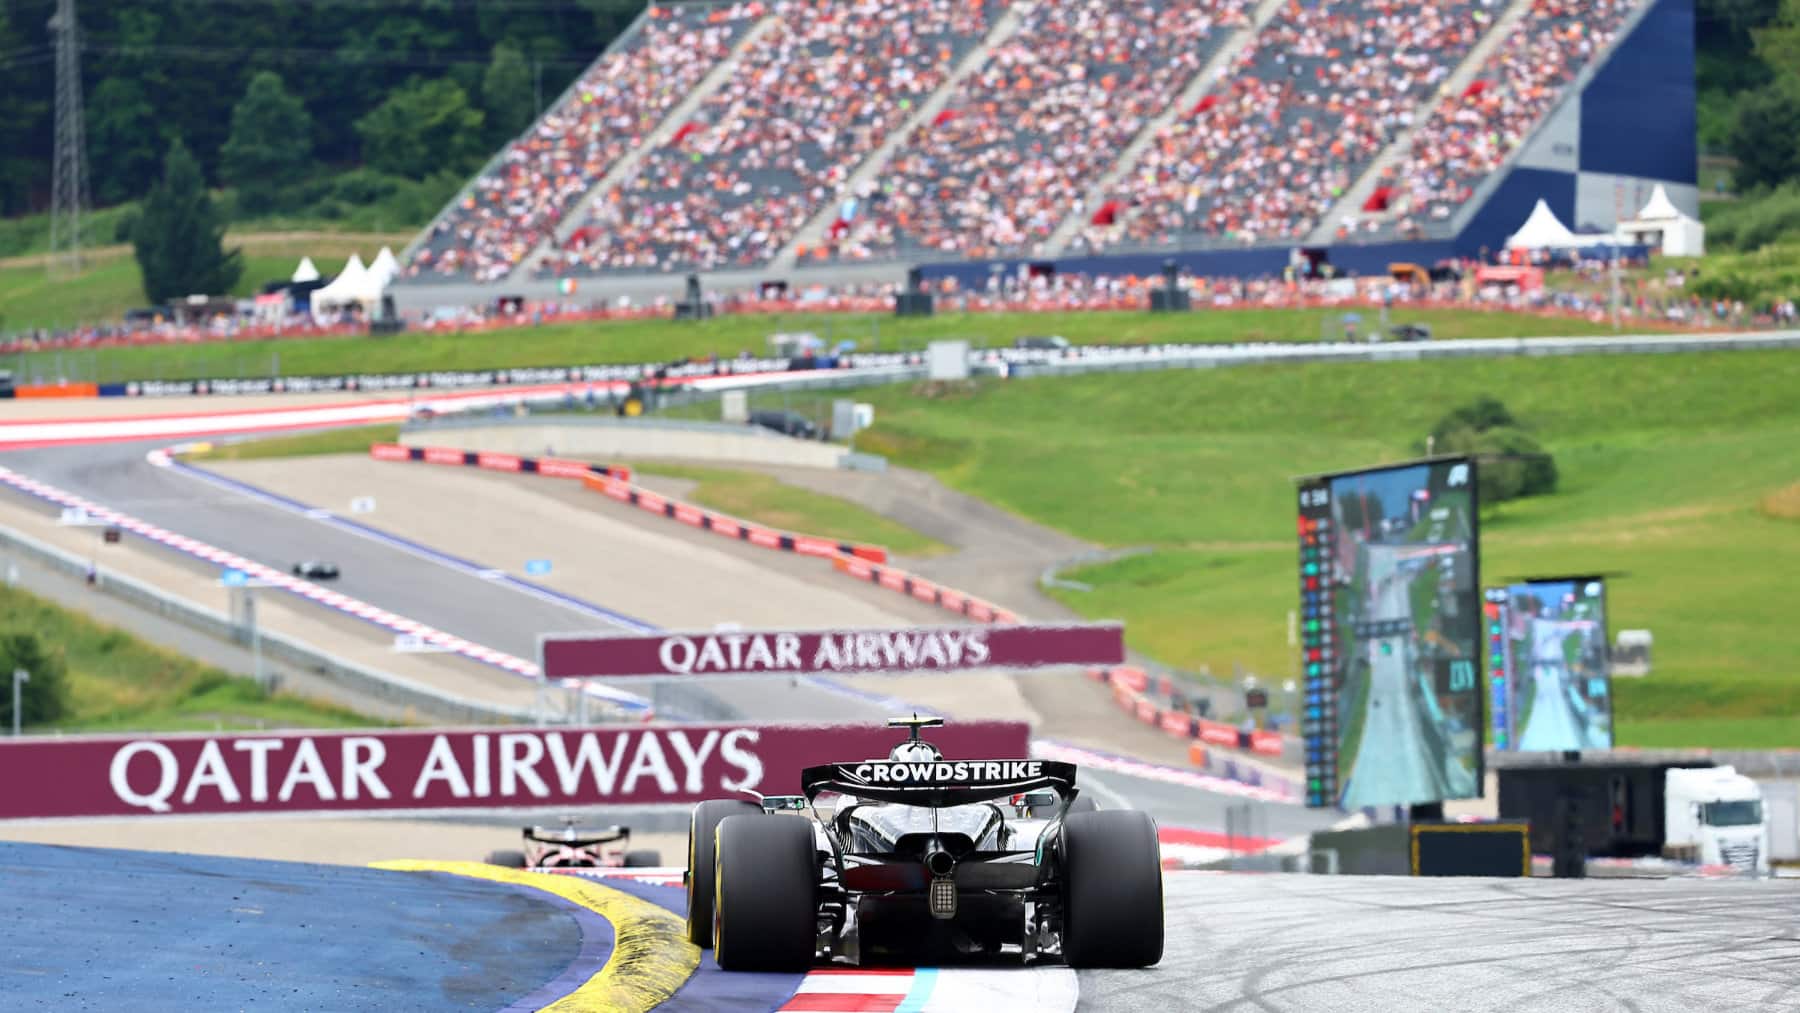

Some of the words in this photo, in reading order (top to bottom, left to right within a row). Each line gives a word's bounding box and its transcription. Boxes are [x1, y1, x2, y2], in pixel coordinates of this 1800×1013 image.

[657, 633, 802, 674] QATAR
[814, 632, 989, 670] AIRWAYS
[109, 738, 391, 812] QATAR
[413, 728, 763, 799] AIRWAYS
[855, 761, 1042, 783] CROWDSTRIKE
